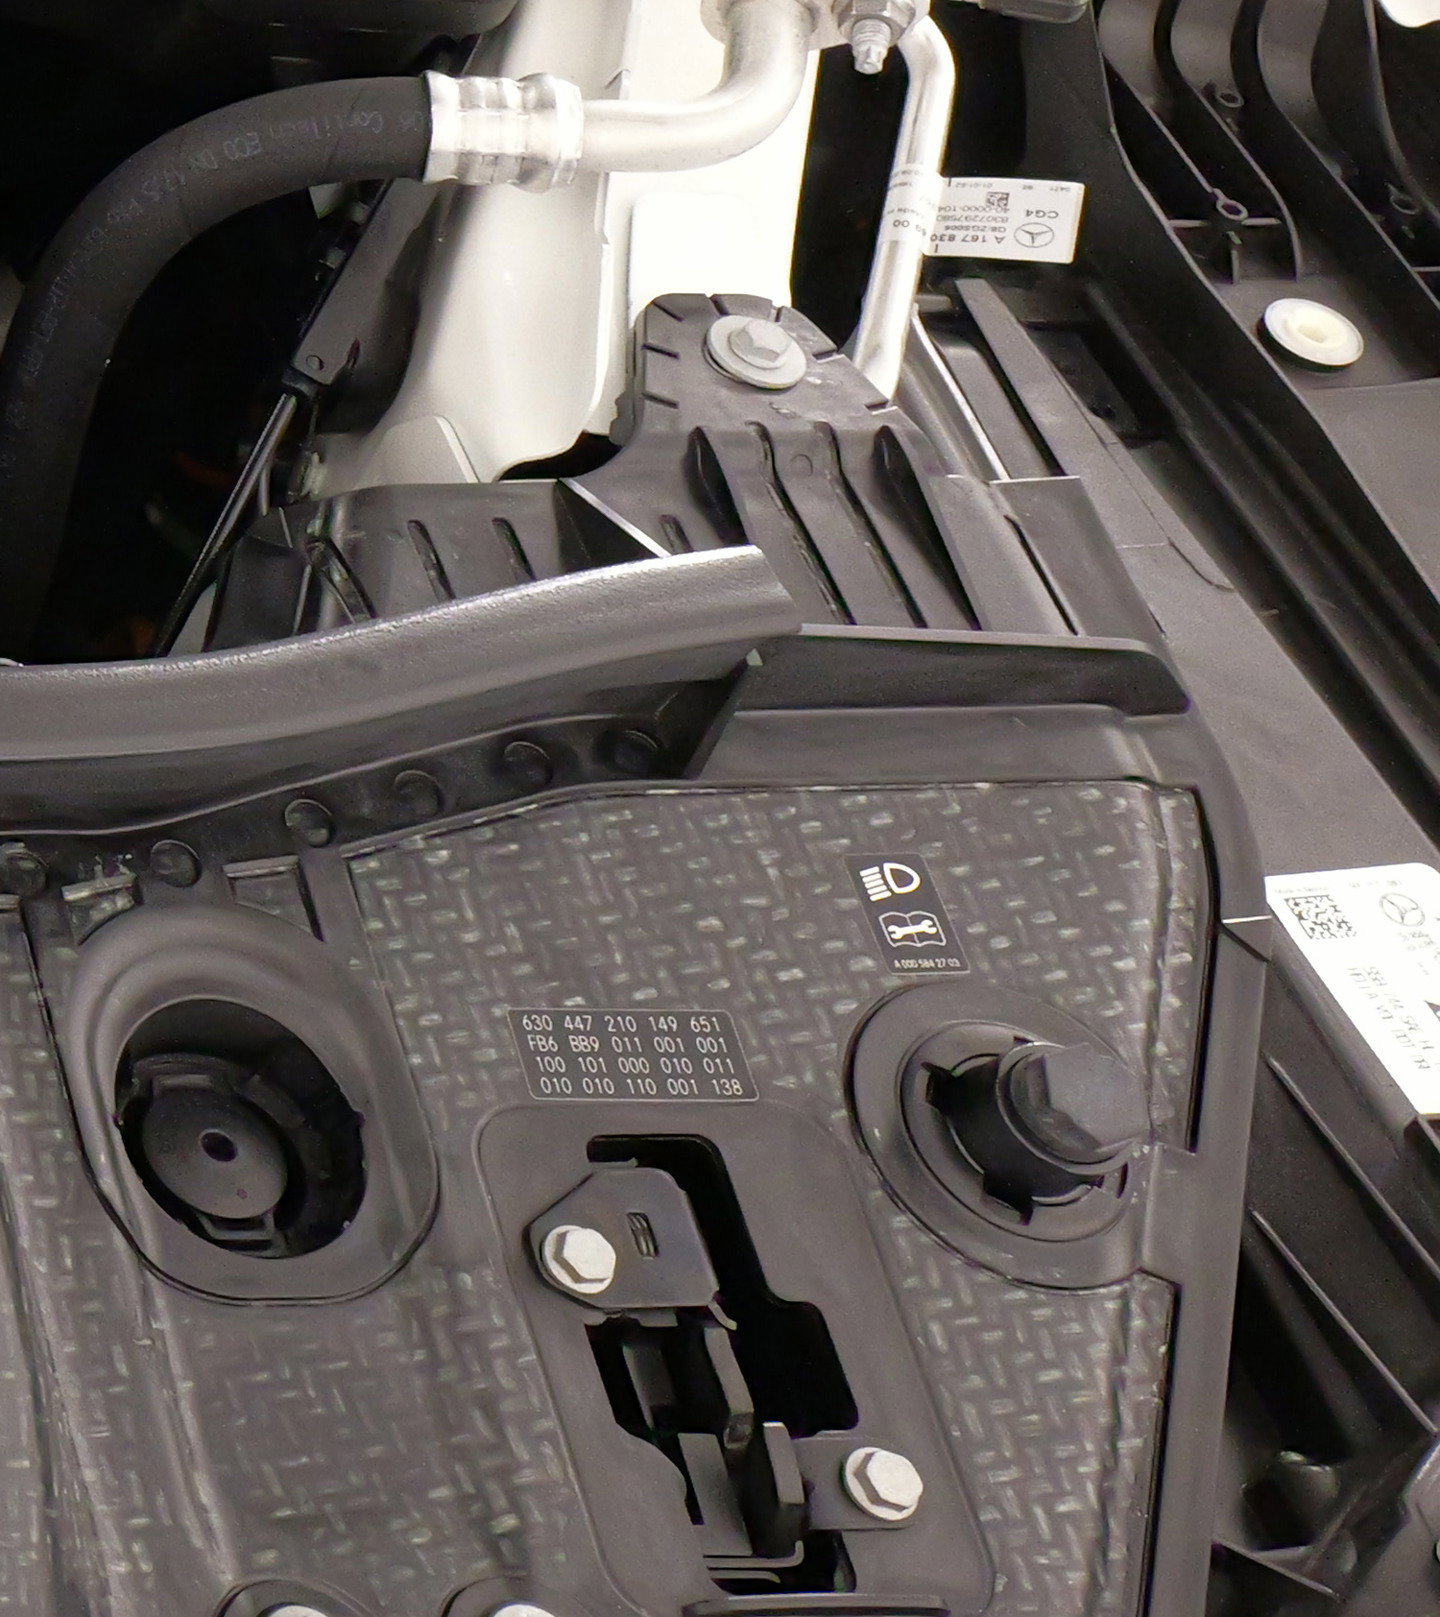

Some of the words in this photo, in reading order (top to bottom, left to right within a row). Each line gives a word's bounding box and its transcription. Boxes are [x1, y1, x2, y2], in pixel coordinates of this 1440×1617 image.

[961, 233, 987, 243] 167
[994, 235, 1006, 244] A
[522, 1014, 553, 1033] 630
[564, 1014, 593, 1033] 447
[604, 1014, 637, 1033] 210
[648, 1014, 678, 1033] 149
[690, 1014, 721, 1033] 651
[527, 1035, 559, 1053] FB6
[569, 1035, 600, 1053] BB9
[611, 1035, 643, 1053] 011
[653, 1035, 685, 1053] 001
[696, 1035, 728, 1053] 001
[536, 1056, 567, 1074] 100
[578, 1056, 609, 1074] 101
[618, 1056, 650, 1074] 000
[660, 1056, 693, 1074] 010
[703, 1056, 735, 1074] 011
[539, 1077, 573, 1096] 010
[582, 1077, 616, 1096] 010
[626, 1077, 657, 1096] 110
[667, 1077, 699, 1096] 001
[711, 1077, 744, 1096] 138
